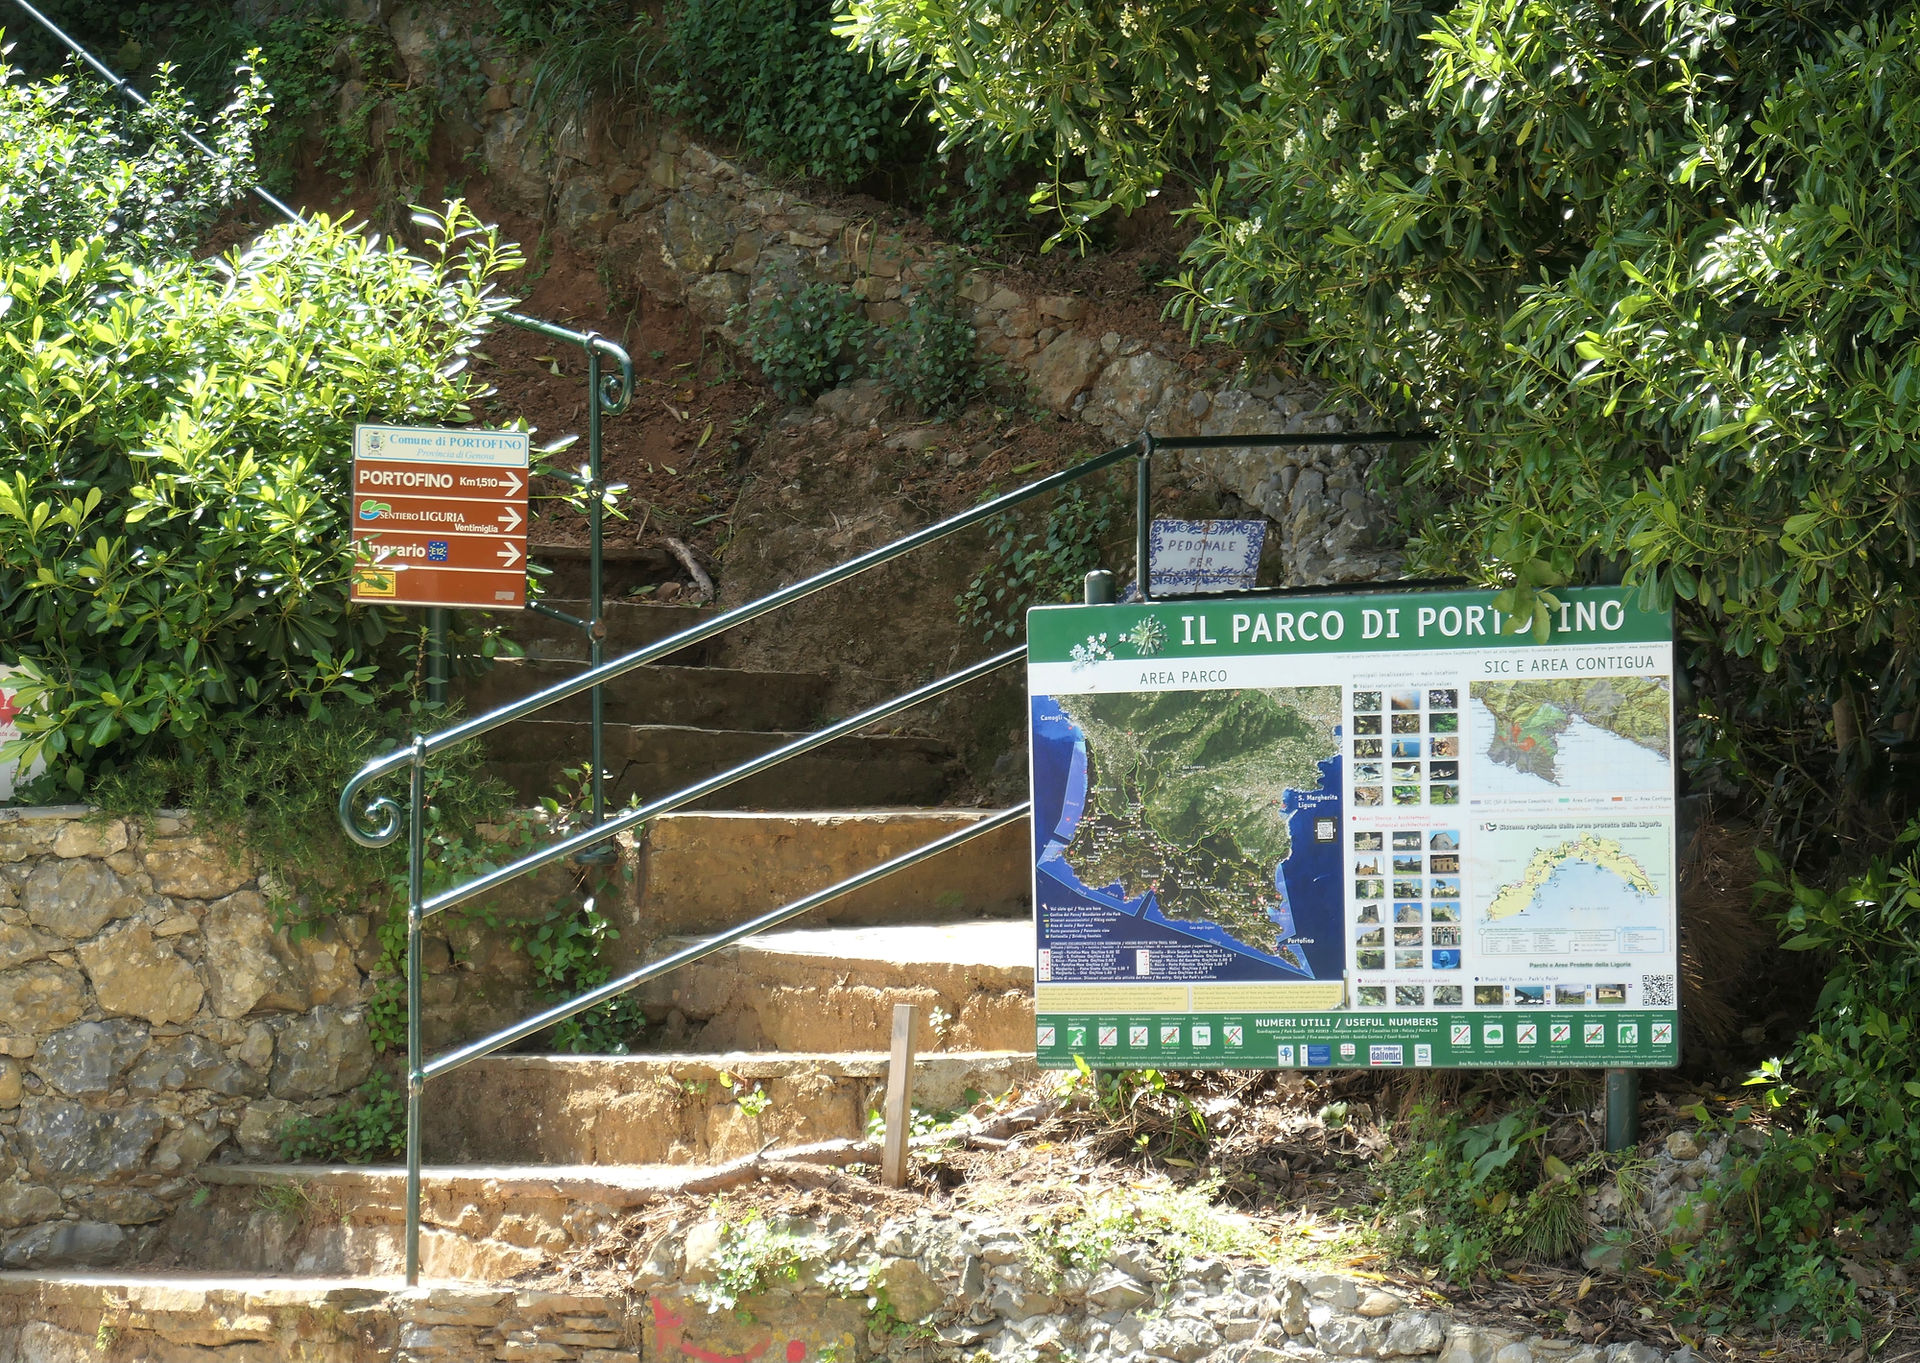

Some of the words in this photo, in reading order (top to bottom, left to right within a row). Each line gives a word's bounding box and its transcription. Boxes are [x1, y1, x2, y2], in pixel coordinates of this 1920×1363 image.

[389, 433, 432, 446] Comune
[435, 435, 446, 446] di
[449, 437, 522, 450] PORTOFINO
[416, 448, 455, 459] Provincia
[456, 449, 465, 459] di
[465, 451, 495, 460] Genova
[359, 470, 453, 488] PORTOFINO
[380, 511, 418, 521] SENTIERO
[419, 511, 465, 523] LIGURIA
[454, 523, 498, 534] Ventimiglia
[357, 541, 426, 558] Iinerario
[1167, 540, 1237, 551] PEDONALE
[1189, 557, 1213, 567] PER
[1181, 615, 1217, 645] IL
[1232, 610, 1345, 643] PARCO
[1361, 608, 1400, 639] DI
[1418, 600, 1625, 637] PORTINO
[1484, 660, 1510, 674] SIC
[1516, 660, 1525, 672] E
[1531, 658, 1569, 672] AREA
[1576, 655, 1655, 670] CONTIGUA
[1140, 671, 1175, 684] AREA
[1182, 669, 1228, 683] PARCO
[1040, 714, 1063, 723] Camogli
[1306, 794, 1338, 802] Margherita
[1298, 802, 1317, 810] Ligure
[1287, 937, 1315, 945] Portofino
[1255, 1018, 1297, 1027] NUMERI
[1300, 1018, 1331, 1027] UTILI
[1345, 1018, 1385, 1027] USEFUL
[1389, 1018, 1439, 1026] NUMBERS
